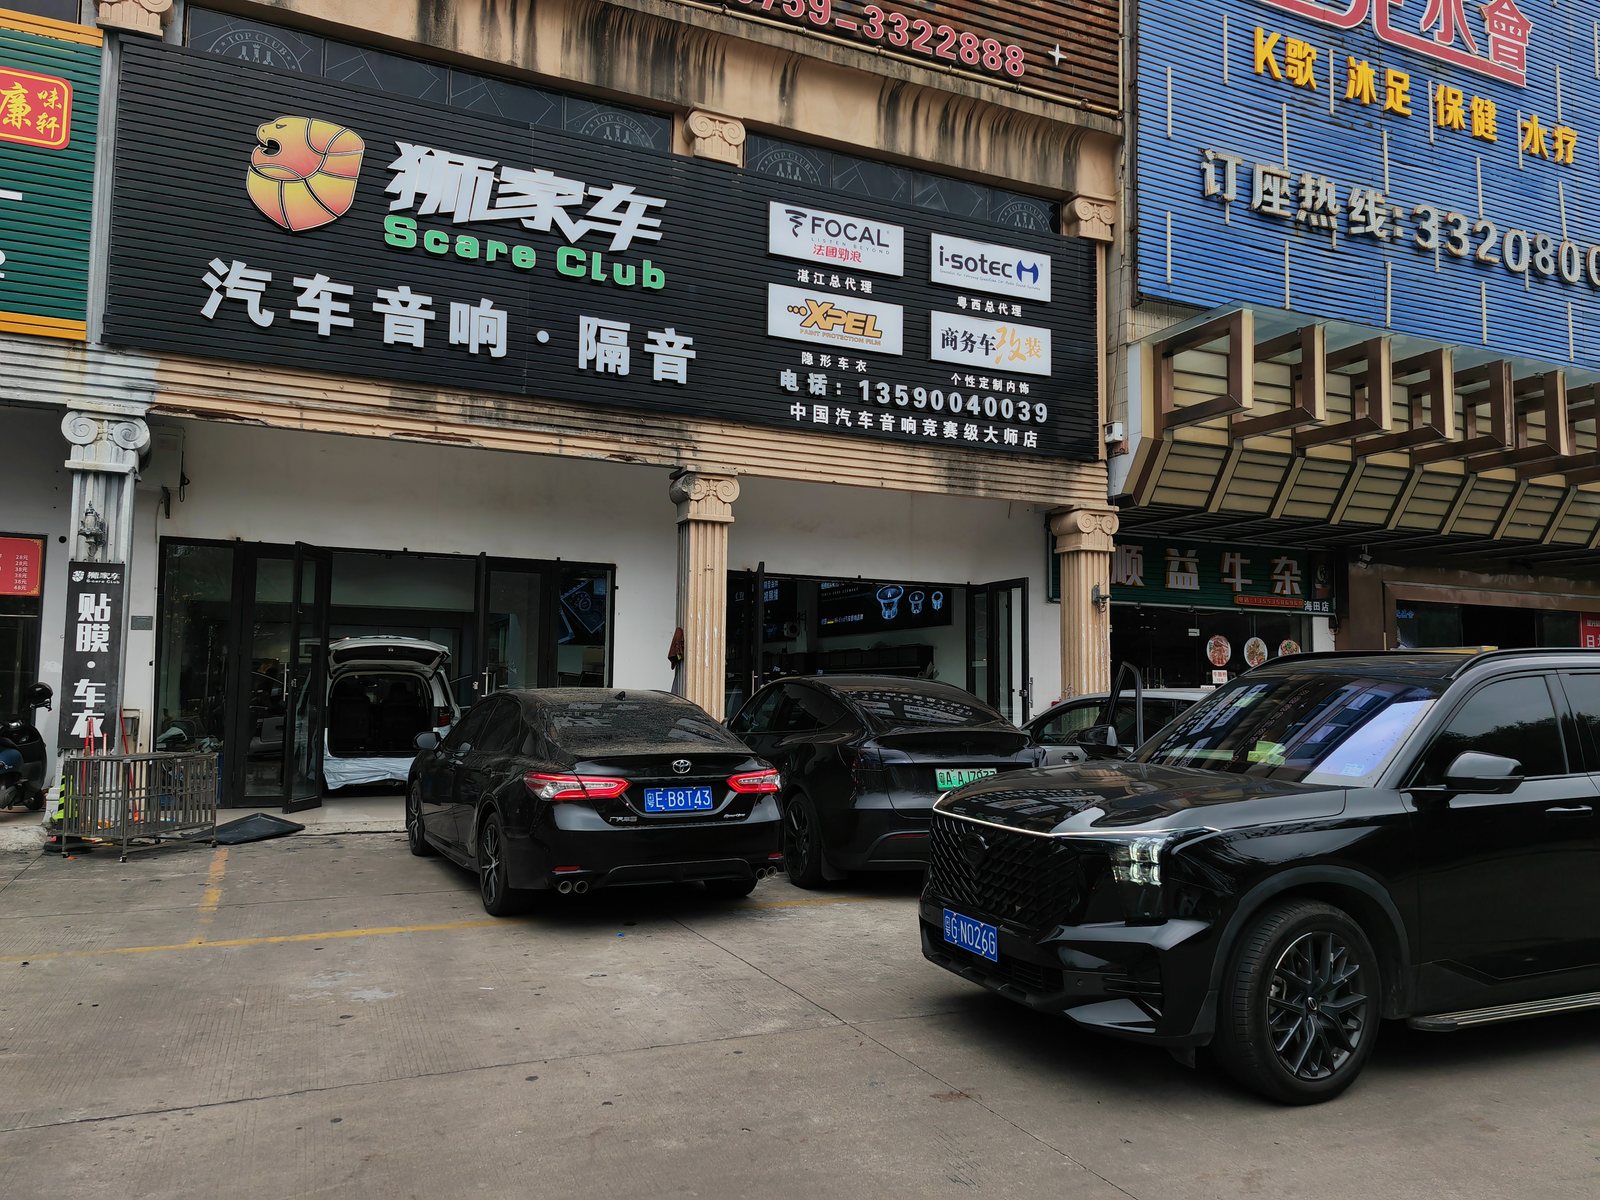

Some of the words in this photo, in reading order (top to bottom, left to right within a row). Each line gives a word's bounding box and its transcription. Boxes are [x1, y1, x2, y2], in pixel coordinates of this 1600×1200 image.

[226, 32, 251, 44] TOP
[255, 33, 288, 56] CLUB
[734, 0, 1025, 78] 59-3322888
[1254, 26, 1317, 90] K歌
[1345, 55, 1412, 117] 沐足
[1433, 84, 1498, 142] 保健
[1520, 114, 1578, 164] 水疗
[594, 114, 613, 126] TOP
[384, 141, 667, 251] 狮家车
[811, 216, 890, 248] FOCAL
[811, 237, 847, 246] LISTEN
[853, 244, 890, 255] BEYOND
[384, 214, 537, 269] Scare
[556, 245, 666, 290] Club
[813, 243, 862, 263] 法國勁浪
[939, 245, 1013, 278] i-sotec
[797, 268, 873, 294] 湛江总代理
[799, 298, 883, 338] XPEL
[957, 296, 1022, 317] 粤西总代理
[800, 328, 821, 337] PAINT
[822, 332, 865, 344] PROTECTION
[865, 338, 882, 346] FILM
[801, 351, 867, 373] 隐形车衣
[950, 373, 1030, 394] 个性定制内饰
[790, 402, 1038, 448] 中国汽车音响竞赛级大师店
[1110, 544, 1301, 595] 顺益牛杂
